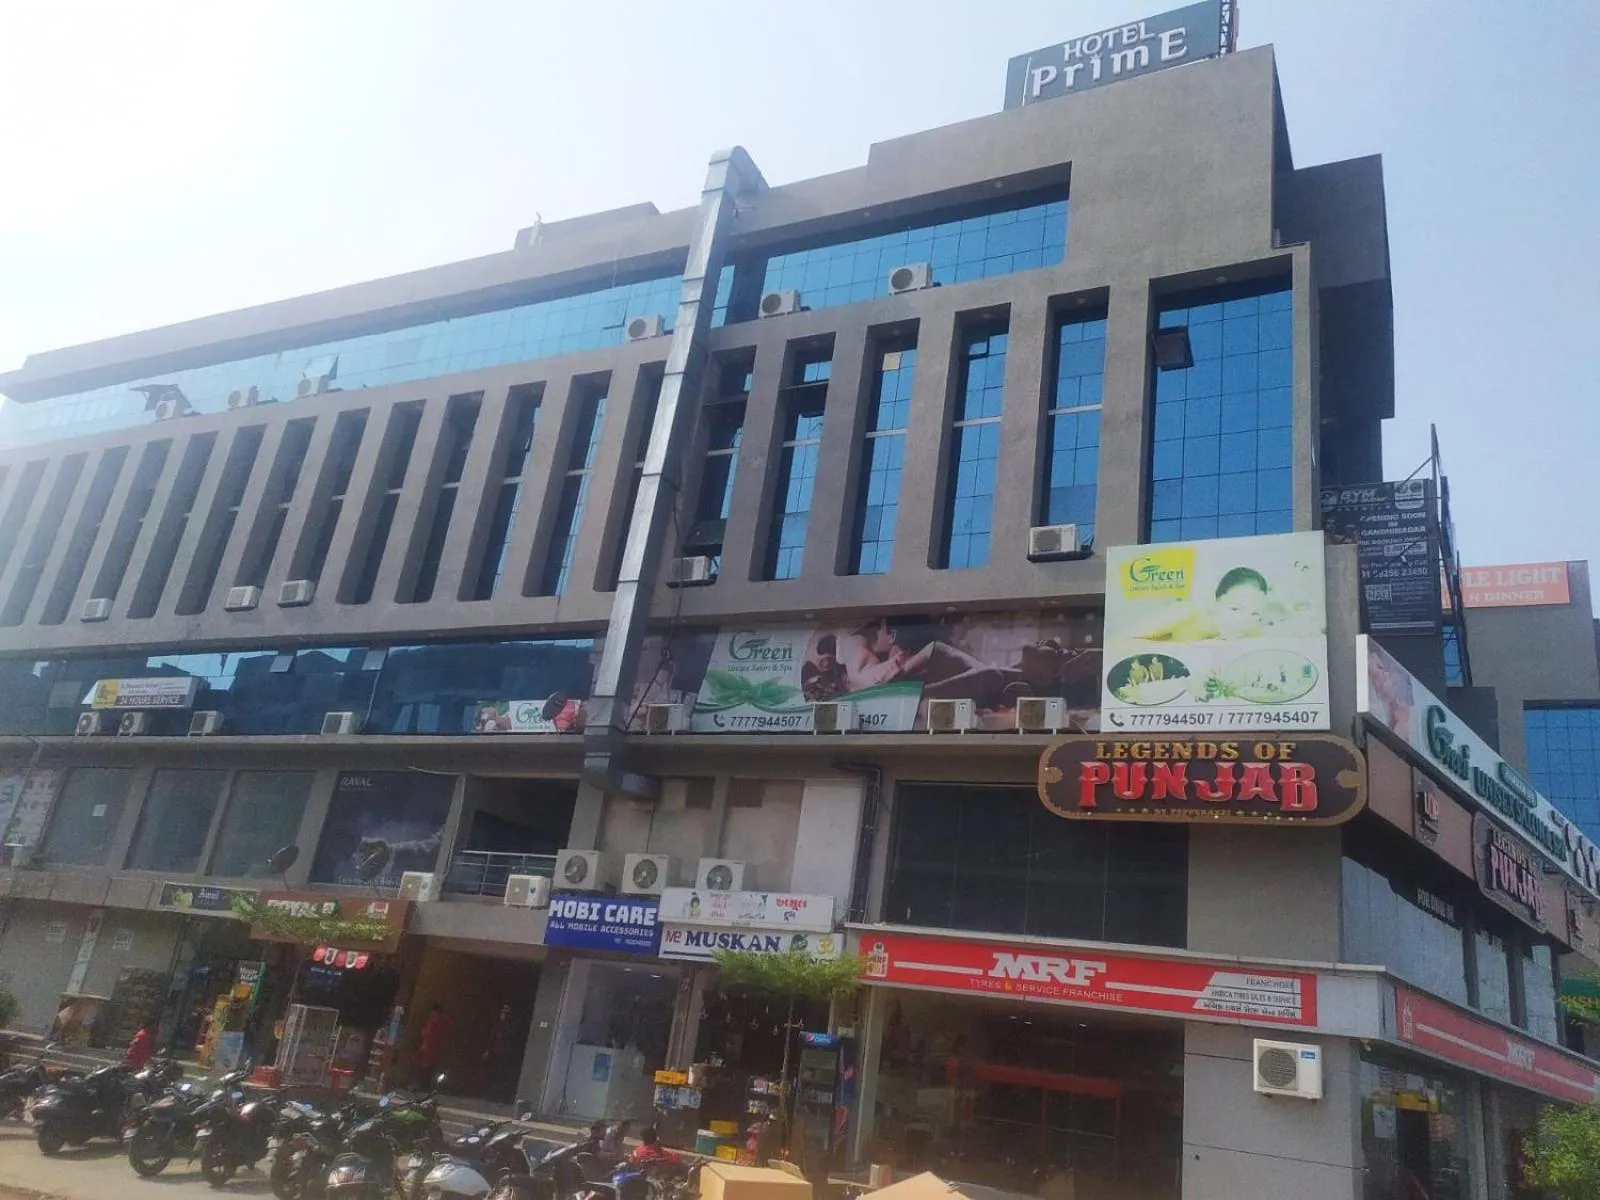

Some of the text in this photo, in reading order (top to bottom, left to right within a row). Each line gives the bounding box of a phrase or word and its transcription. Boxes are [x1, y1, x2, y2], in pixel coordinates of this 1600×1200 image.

[1064, 22, 1156, 62] HOTEL
[1129, 558, 1184, 583] Green
[1498, 566, 1562, 587] LIGHT
[1485, 590, 1545, 602] DINNER
[729, 630, 793, 661] Green
[729, 716, 803, 728] 7777944507
[1130, 713, 1214, 726] 7777944507
[1227, 711, 1319, 724] 7777945407
[1095, 742, 1298, 761] LEGENDS OF
[1078, 761, 1319, 813] PUNJAB
[548, 900, 657, 926] MOBI CARE
[550, 920, 654, 937] ALL MOBILE ACCESSORIES
[685, 930, 782, 953] MUSKAN
[988, 952, 1106, 986] MRF
[969, 978, 1001, 990] TYRES
[1015, 983, 1060, 997] SERVICE
[1062, 989, 1123, 1003] FRANCHISE
